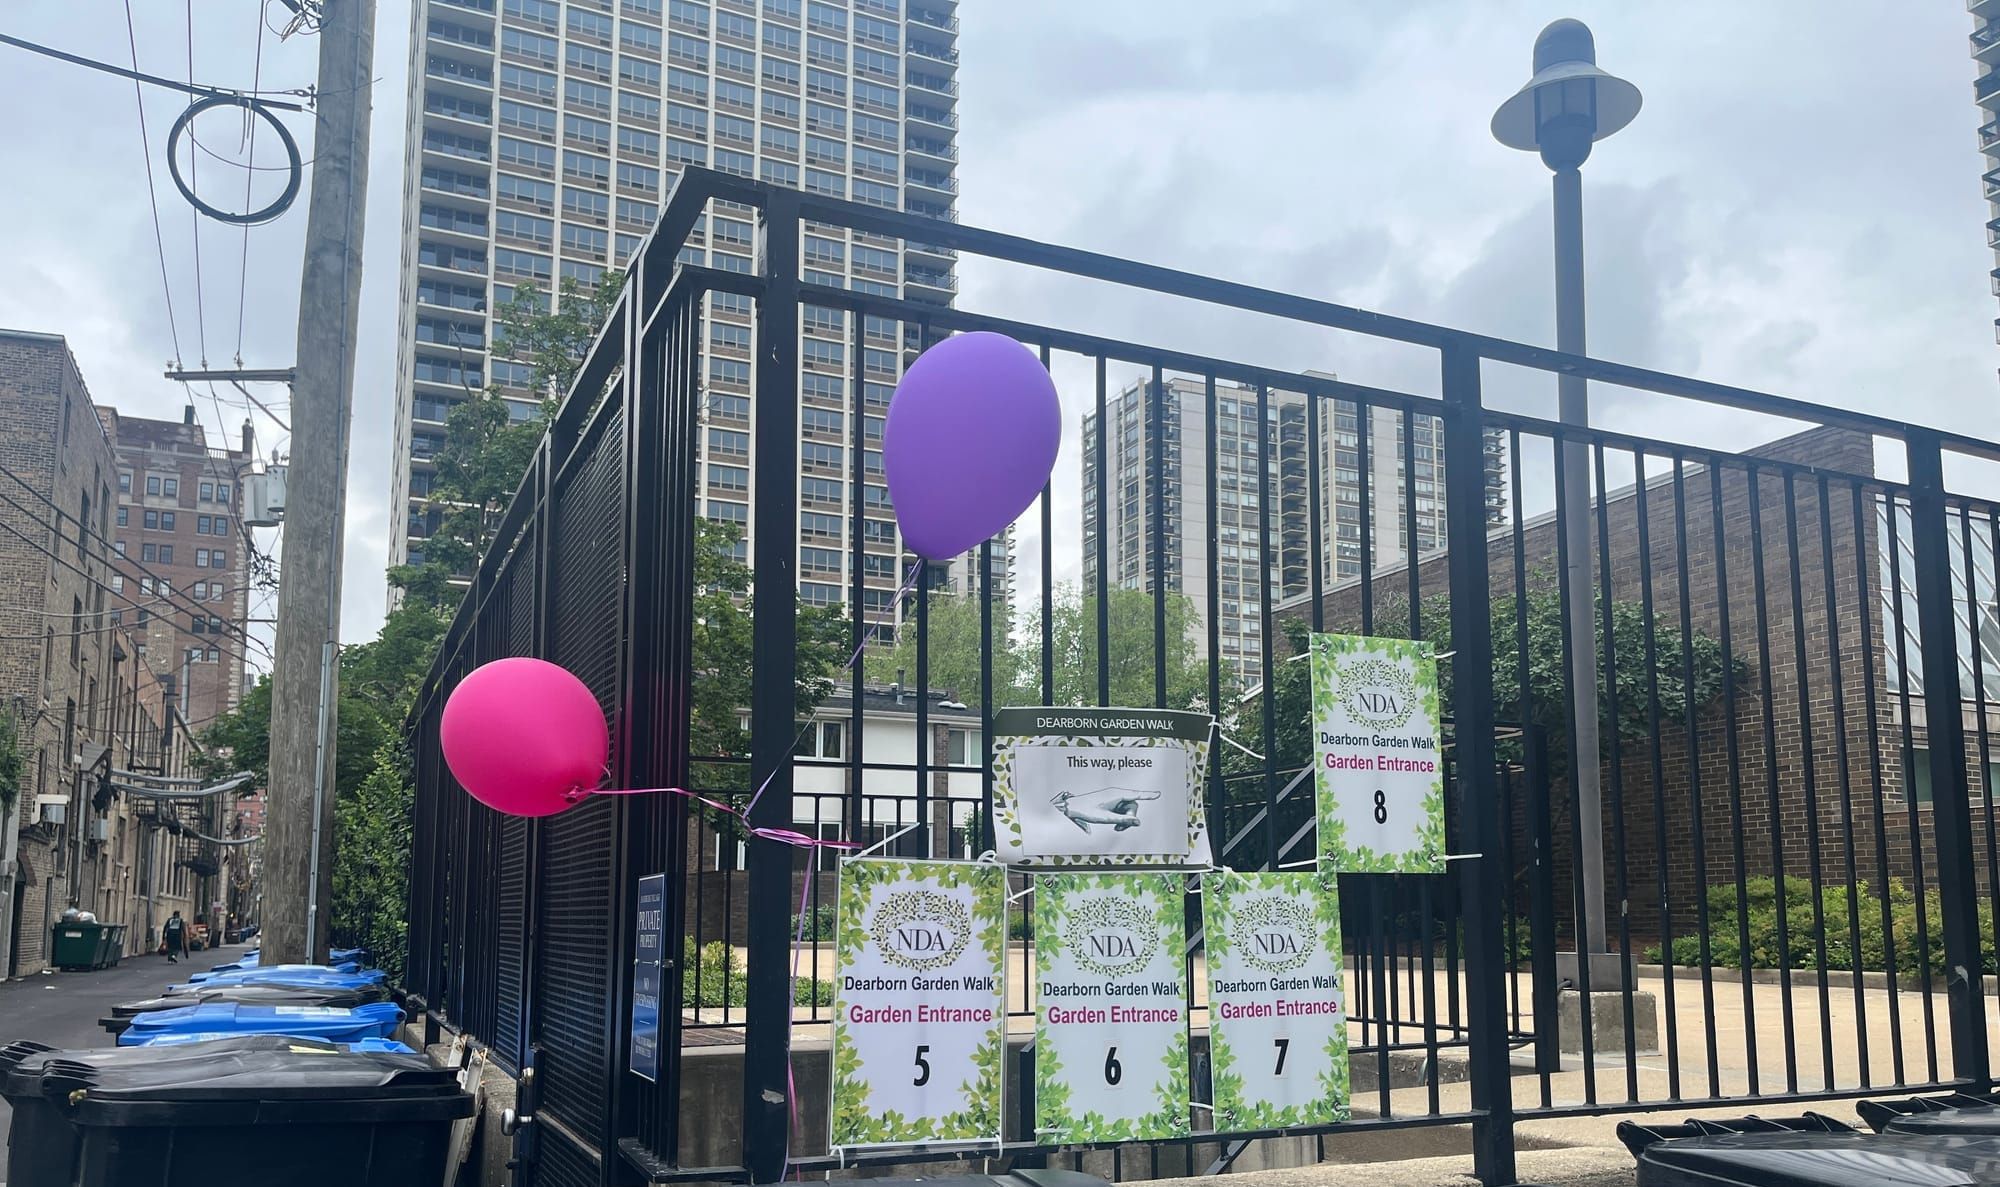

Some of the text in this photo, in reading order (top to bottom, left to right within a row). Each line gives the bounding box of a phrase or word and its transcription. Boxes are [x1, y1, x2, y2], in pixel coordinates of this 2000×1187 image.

[1358, 693, 1399, 714] NDA
[1037, 717, 1174, 731] DEARBORN GARDEN WALK
[1321, 732, 1435, 749] Dearborn Garden Walk
[1067, 757, 1152, 770] This way, please
[1326, 753, 1434, 772] Garden Entrance
[1374, 790, 1387, 824] 8
[897, 929, 945, 951] NDA
[1090, 935, 1136, 957] NDA
[1254, 933, 1297, 954] NDA
[844, 976, 994, 991] Dearborn Garden Walk
[1043, 982, 1179, 997] Dearborn Garden Walk
[1215, 976, 1338, 993] Dearborn Garden Walk
[850, 1005, 992, 1024] Garden Entrance
[1048, 1006, 1178, 1024] Garden Entrance
[1220, 1000, 1337, 1019] Garden Entrance
[913, 1045, 930, 1087] 5
[1104, 1047, 1122, 1086] 6
[1274, 1039, 1289, 1075] 7
